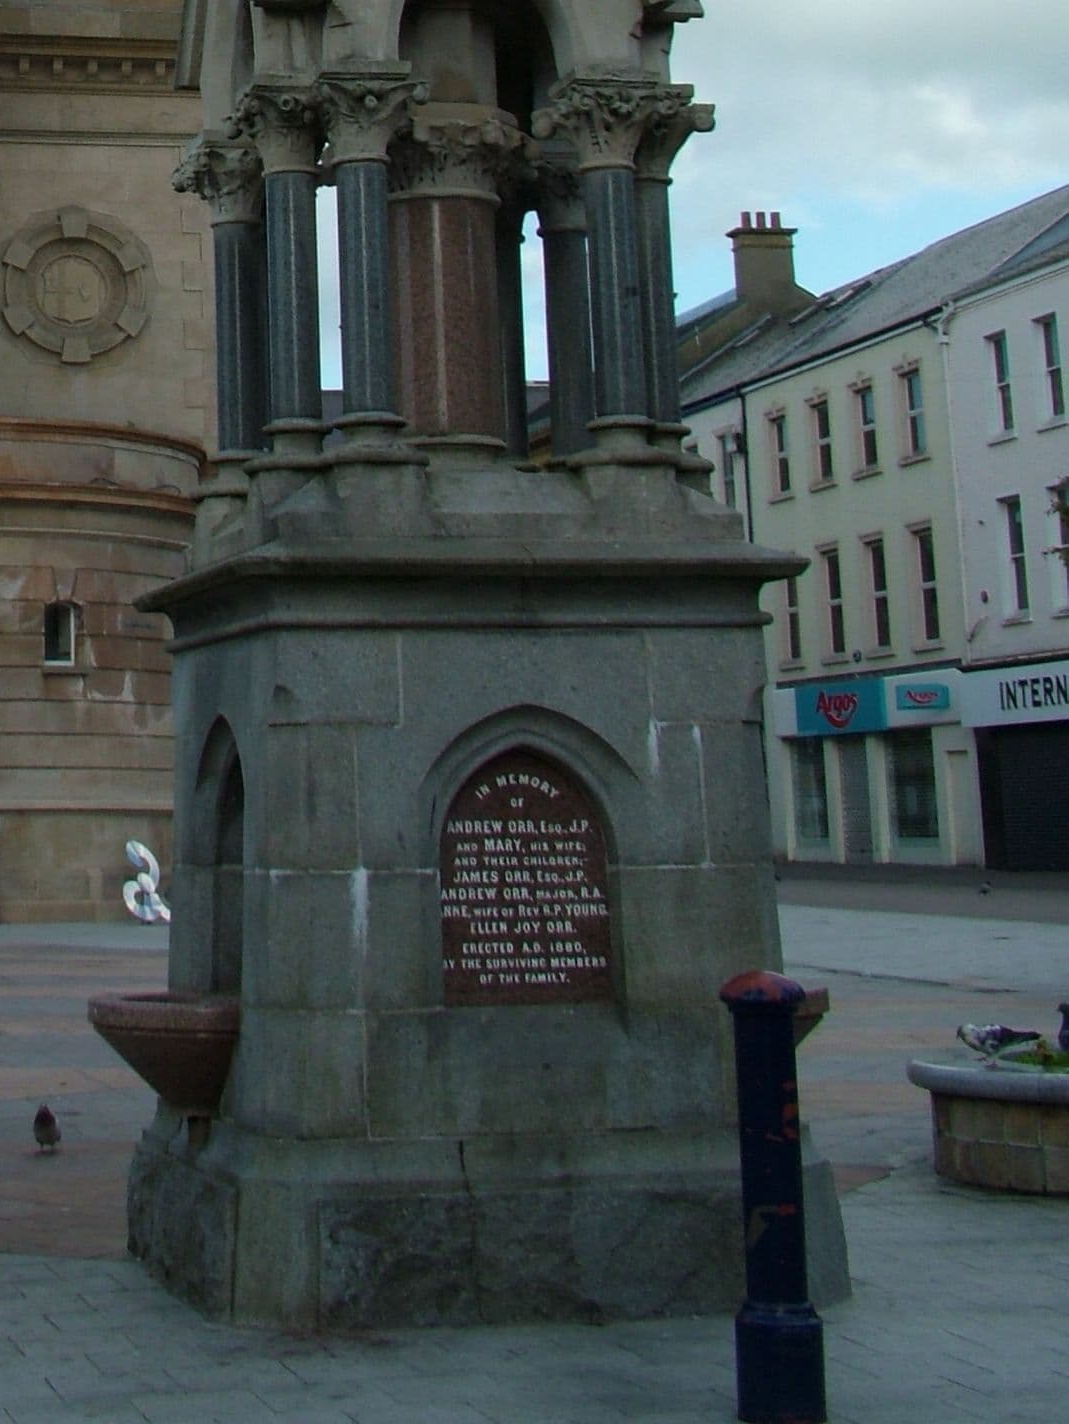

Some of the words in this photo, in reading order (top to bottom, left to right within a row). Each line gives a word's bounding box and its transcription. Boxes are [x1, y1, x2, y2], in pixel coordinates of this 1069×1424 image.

[999, 674, 1069, 710] INTERN
[815, 690, 858, 724] Argos
[474, 783, 491, 800] IN
[495, 773, 560, 799] MEMORY
[446, 819, 503, 834] ANDREW
[508, 820, 538, 835] ORR,
[456, 842, 478, 852] AND
[484, 838, 525, 854] MARY,
[530, 842, 549, 852] HIS
[454, 857, 477, 866] AND
[483, 857, 518, 866] THEIR
[452, 870, 499, 883] JAMES
[441, 887, 498, 901] ANDREW
[470, 921, 508, 934] ELLEN
[514, 921, 541, 934] JOY
[546, 920, 578, 934] ORR.
[462, 942, 514, 954] ERECTED
[461, 958, 482, 969] THE
[486, 957, 547, 969] SURVIVING
[550, 956, 607, 969] MEMBERS
[479, 974, 492, 985] OF
[498, 973, 521, 984] THE
[525, 972, 571, 984] FAMILY.
